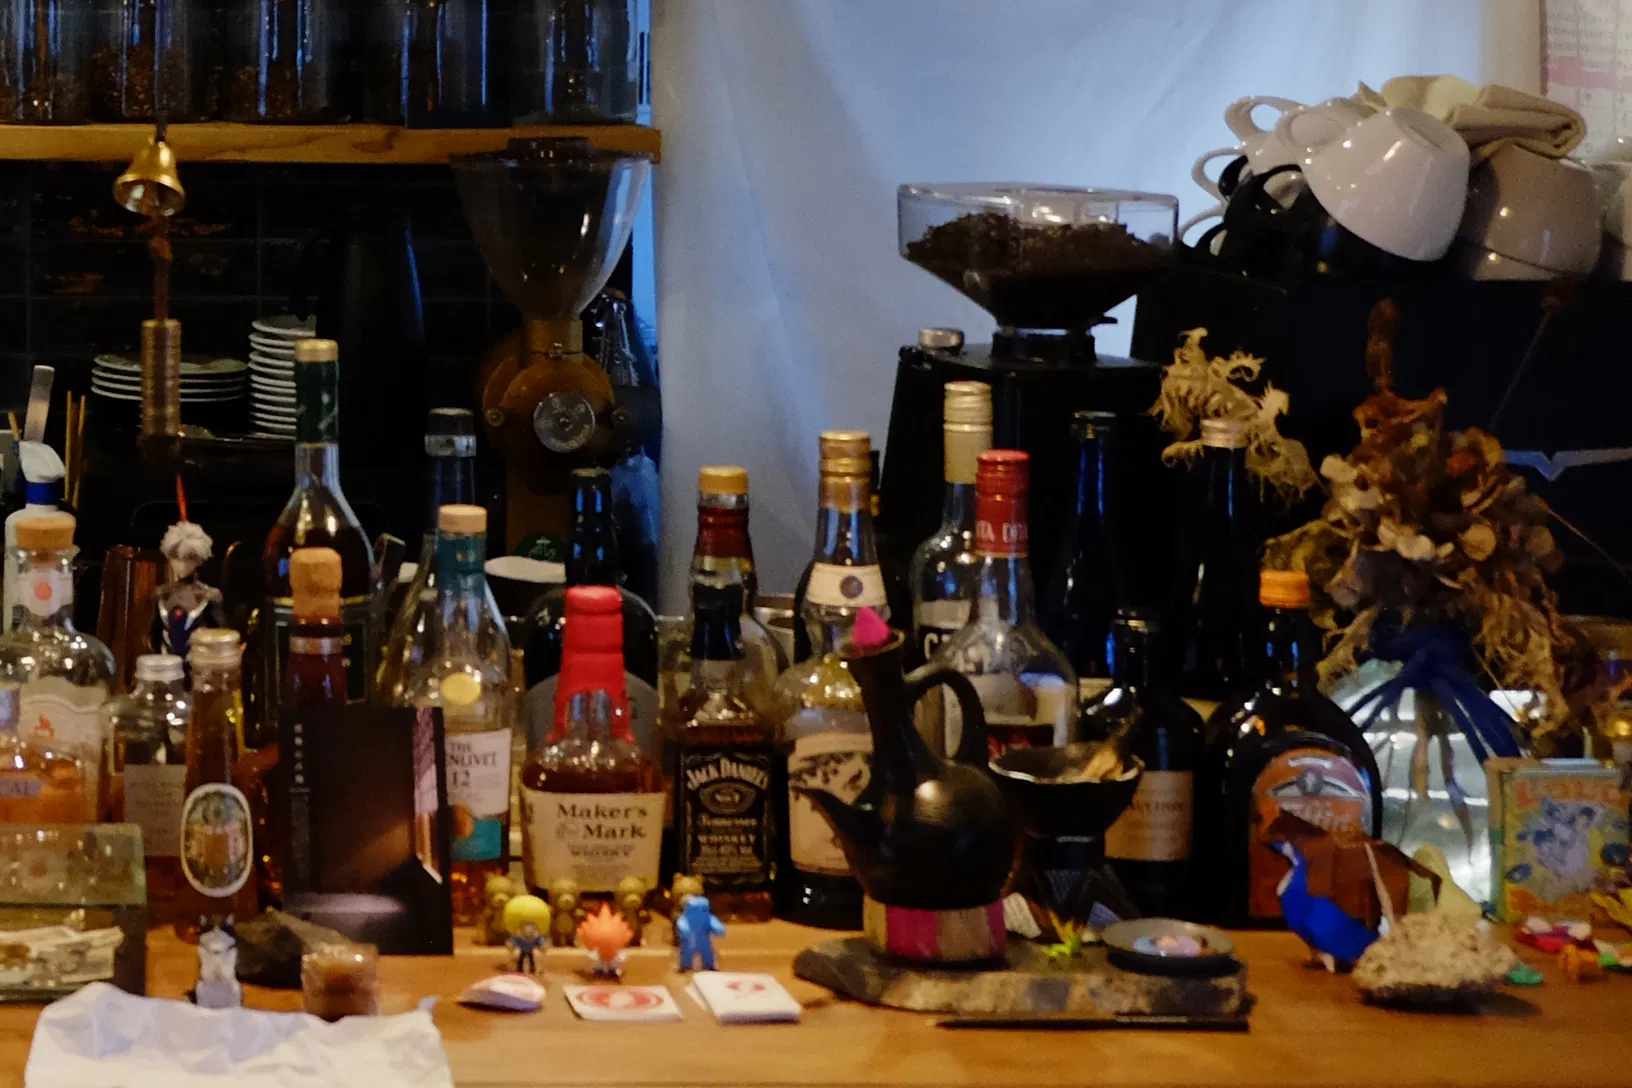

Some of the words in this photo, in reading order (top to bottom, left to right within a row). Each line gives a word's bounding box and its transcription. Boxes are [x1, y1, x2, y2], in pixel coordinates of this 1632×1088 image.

[449, 752, 497, 767] NLIVET
[452, 769, 470, 788] 12
[686, 764, 720, 791] JACK
[556, 803, 648, 819] Maker's
[581, 823, 647, 840] Mark
